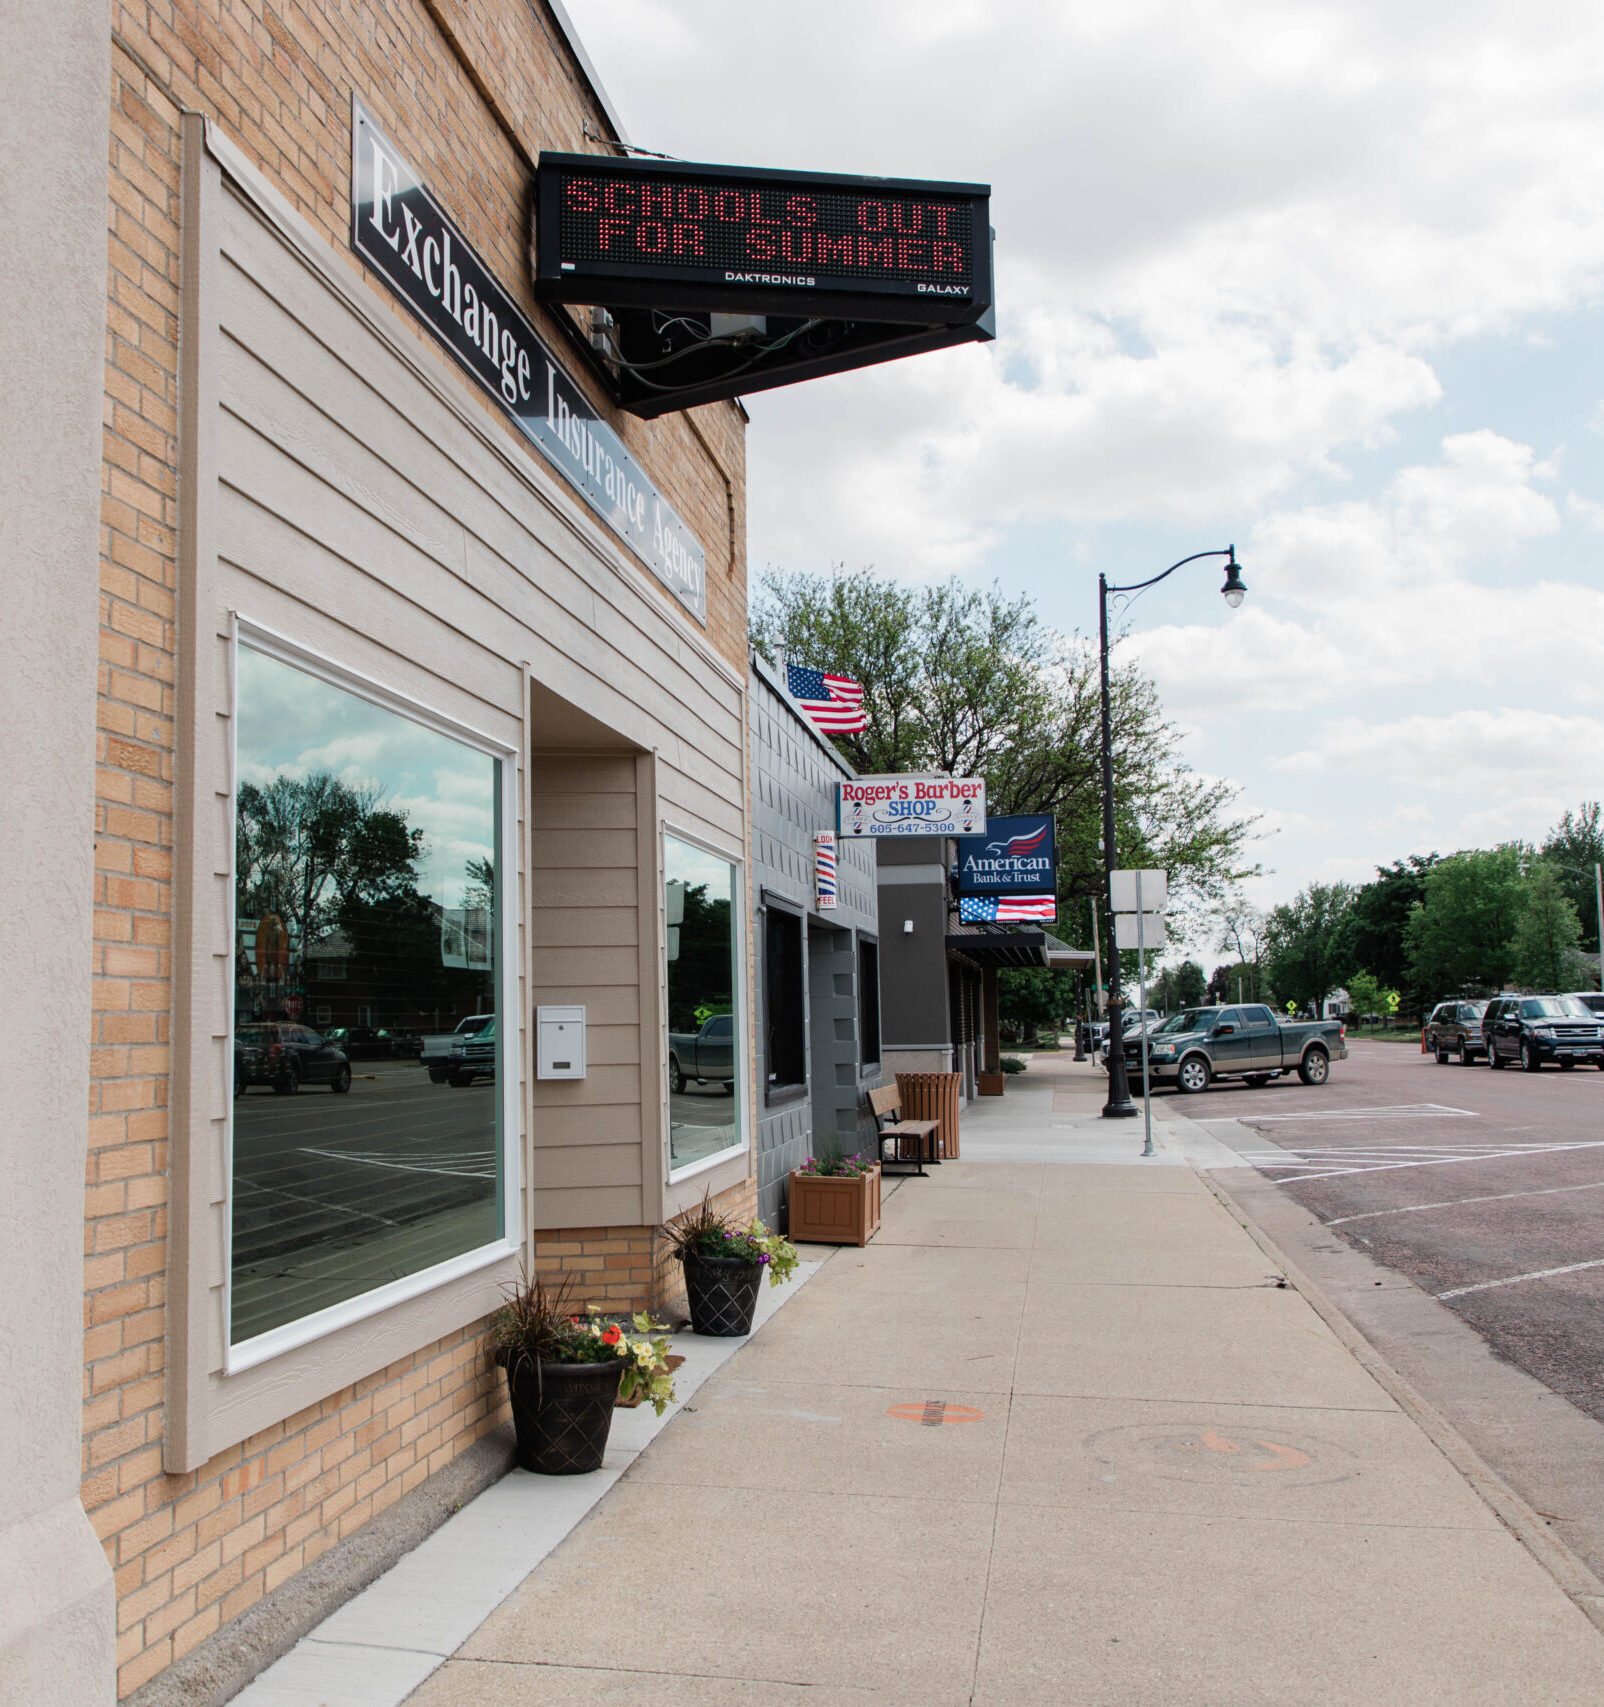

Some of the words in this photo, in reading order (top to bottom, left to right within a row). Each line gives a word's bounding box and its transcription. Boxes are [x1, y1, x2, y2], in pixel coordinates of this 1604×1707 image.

[567, 180, 817, 227] SCHOOLS
[857, 201, 958, 236] OUT
[599, 218, 704, 255] FOR
[746, 229, 963, 272] SUMMER
[724, 271, 816, 286] DAKTRONICS
[916, 283, 970, 295] GALAXY
[369, 136, 531, 404] Exchange
[546, 360, 645, 532] Insurance
[652, 499, 701, 609] Agency
[842, 781, 909, 806] Roger's
[914, 781, 982, 800] Barber
[888, 800, 937, 817] SHOP
[869, 823, 955, 833] 605-647-5300
[963, 854, 1051, 872] American
[973, 871, 1000, 884] Bank
[1001, 873, 1012, 883] &
[1012, 871, 1041, 883] Trust
[818, 895, 835, 905] FEEL
